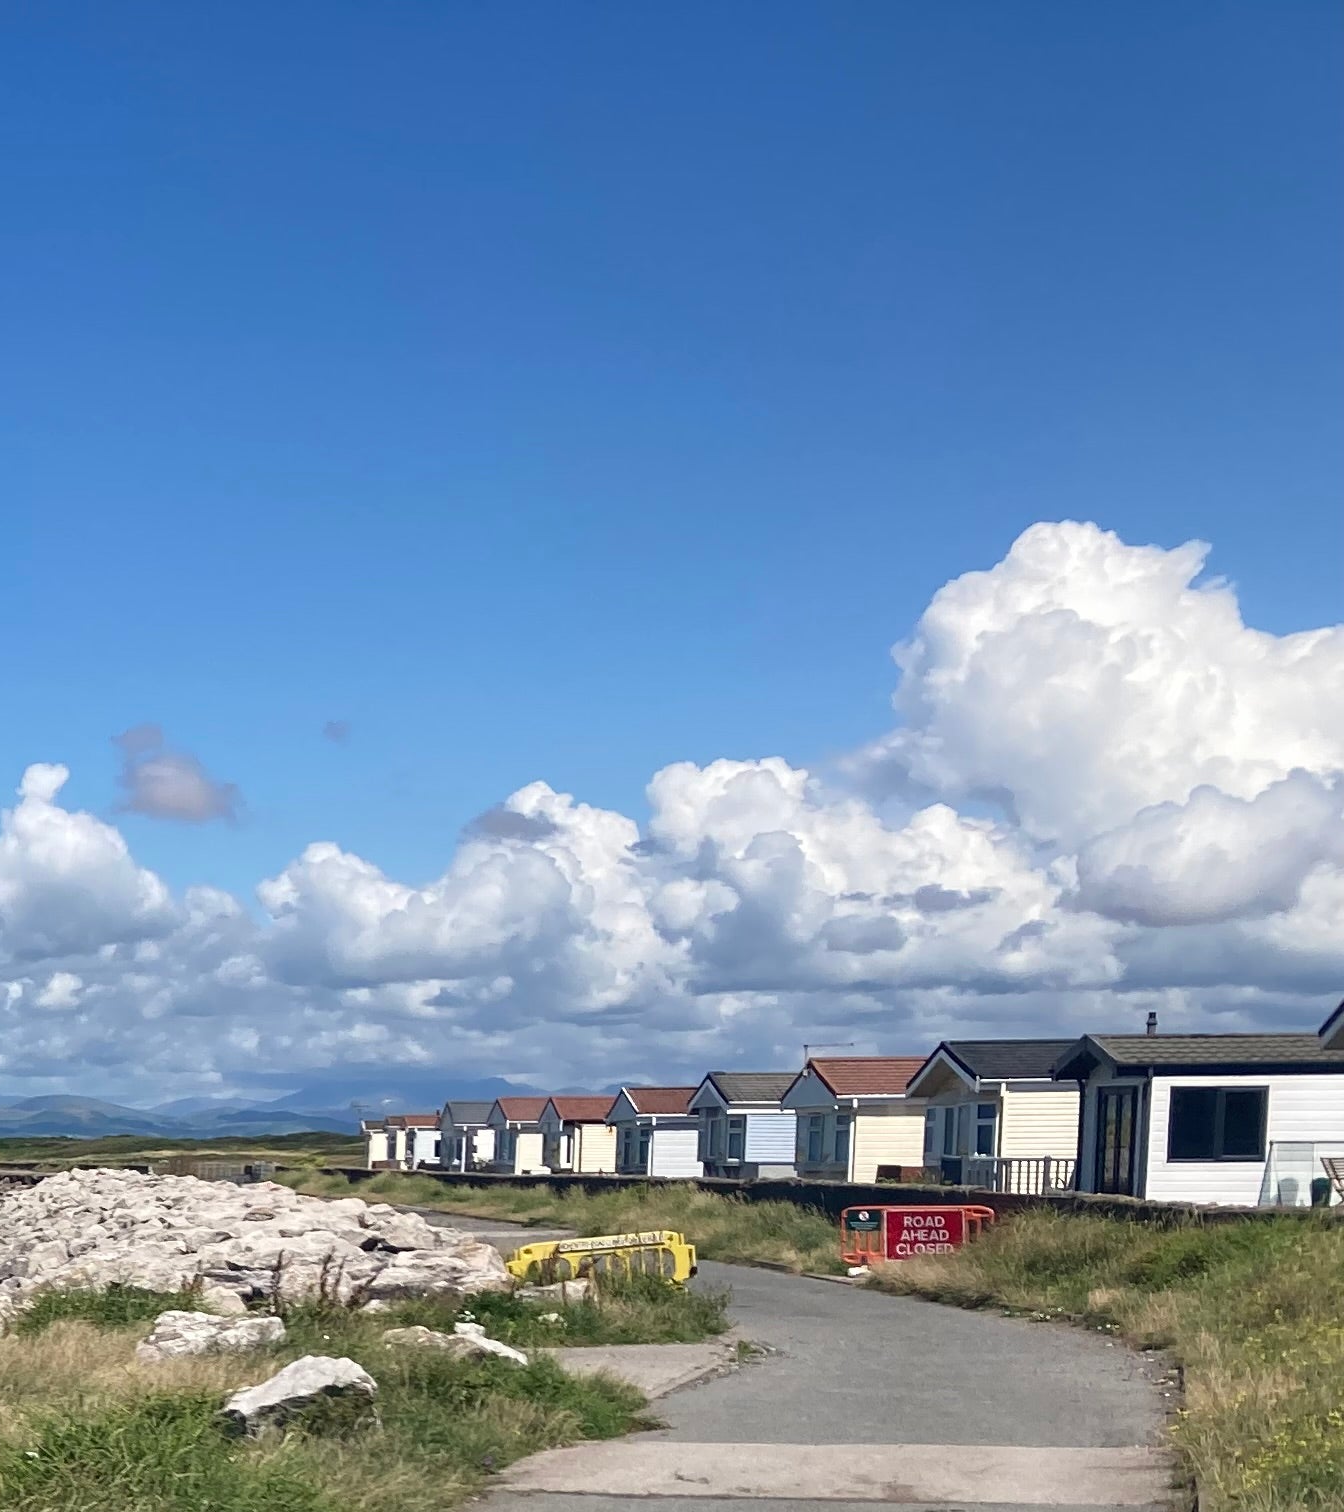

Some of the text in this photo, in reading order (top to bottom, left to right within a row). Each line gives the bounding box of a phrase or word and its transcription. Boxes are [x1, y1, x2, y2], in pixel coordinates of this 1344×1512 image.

[903, 1215, 946, 1228] ROAD
[900, 1229, 950, 1241] AHEAD
[896, 1242, 953, 1255] CLOSED
